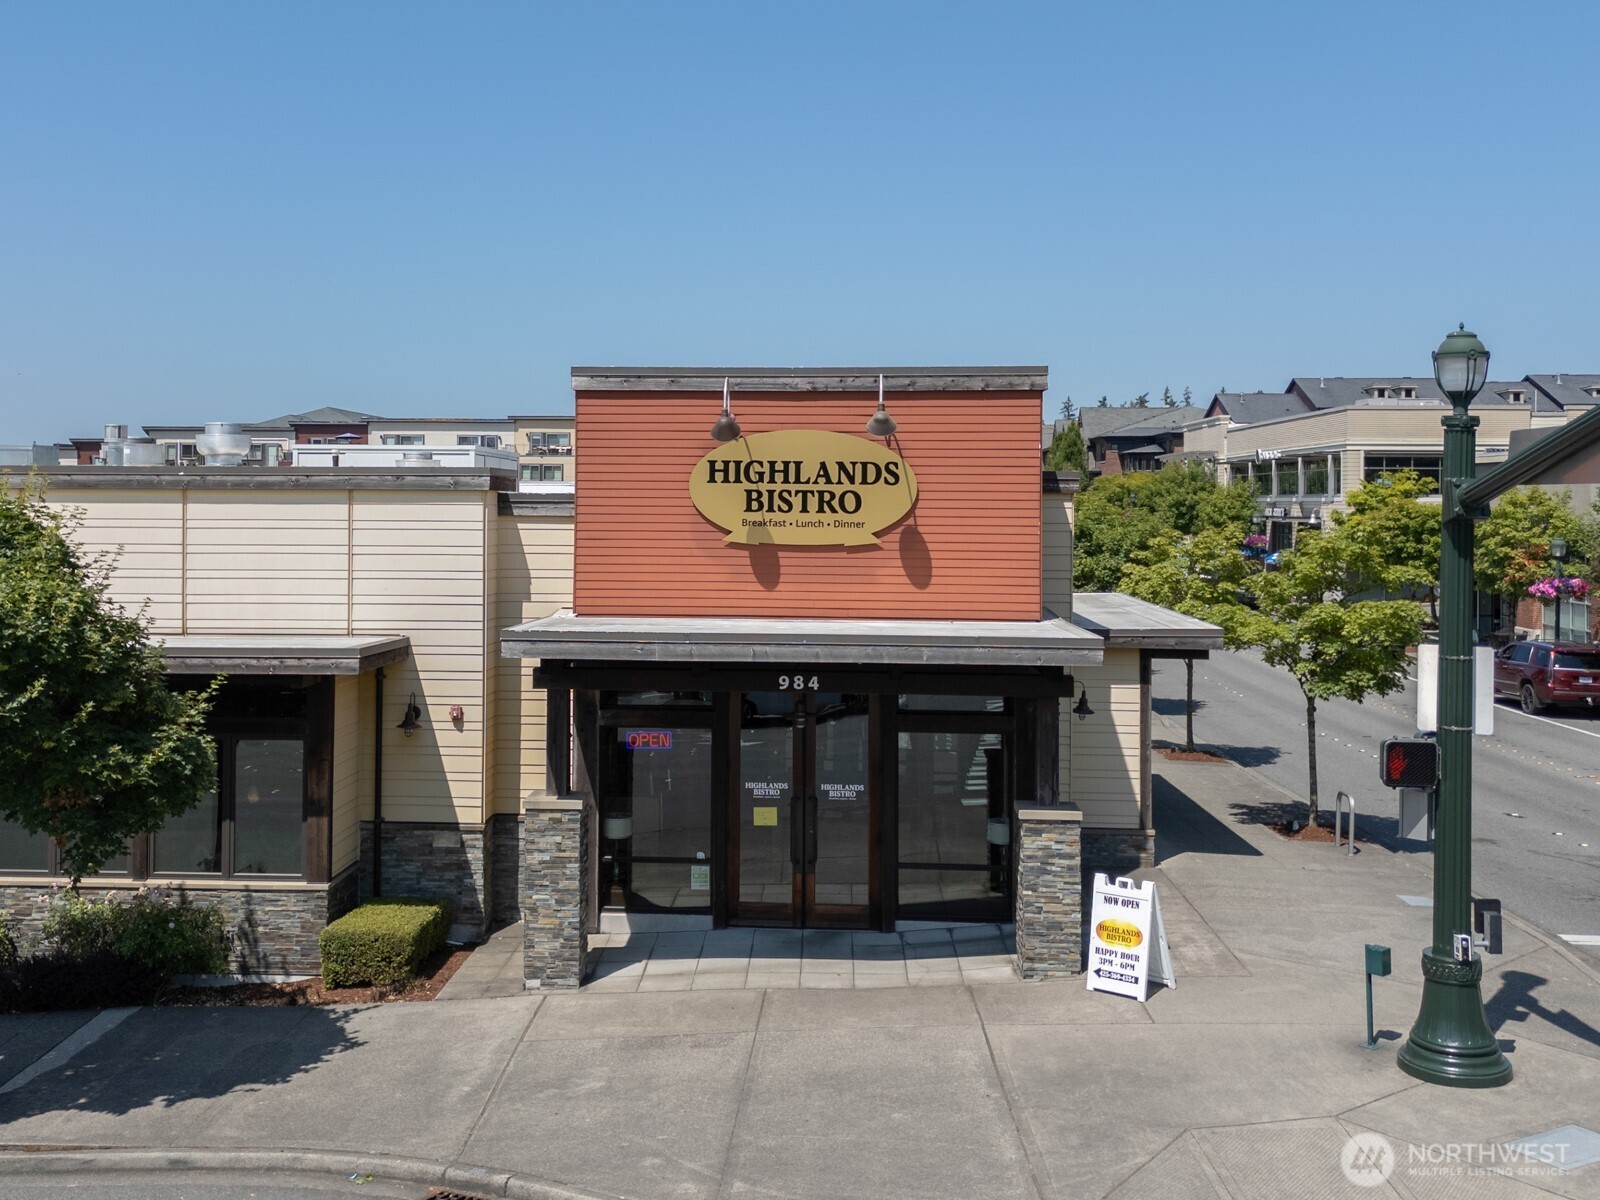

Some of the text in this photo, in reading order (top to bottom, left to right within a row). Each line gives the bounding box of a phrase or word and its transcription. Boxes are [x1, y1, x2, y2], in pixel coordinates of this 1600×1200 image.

[707, 460, 900, 486] HIGHLANDS
[743, 489, 862, 515] BISTRO
[741, 518, 865, 529] Breakfast Lunch Dinner
[778, 675, 820, 691] 984
[628, 733, 670, 748] OPEN
[745, 782, 788, 790] HIGHLANDS
[753, 788, 780, 796] BISTRO
[829, 790, 856, 798] BISTRO
[1104, 896, 1140, 909] NOW OPEN
[1099, 924, 1140, 938] HIGHLANDS
[1106, 932, 1132, 943] BISTRO
[1095, 946, 1140, 963] HAPPY HOUR
[1098, 957, 1114, 968] 3PM
[1120, 961, 1135, 971] 6PM
